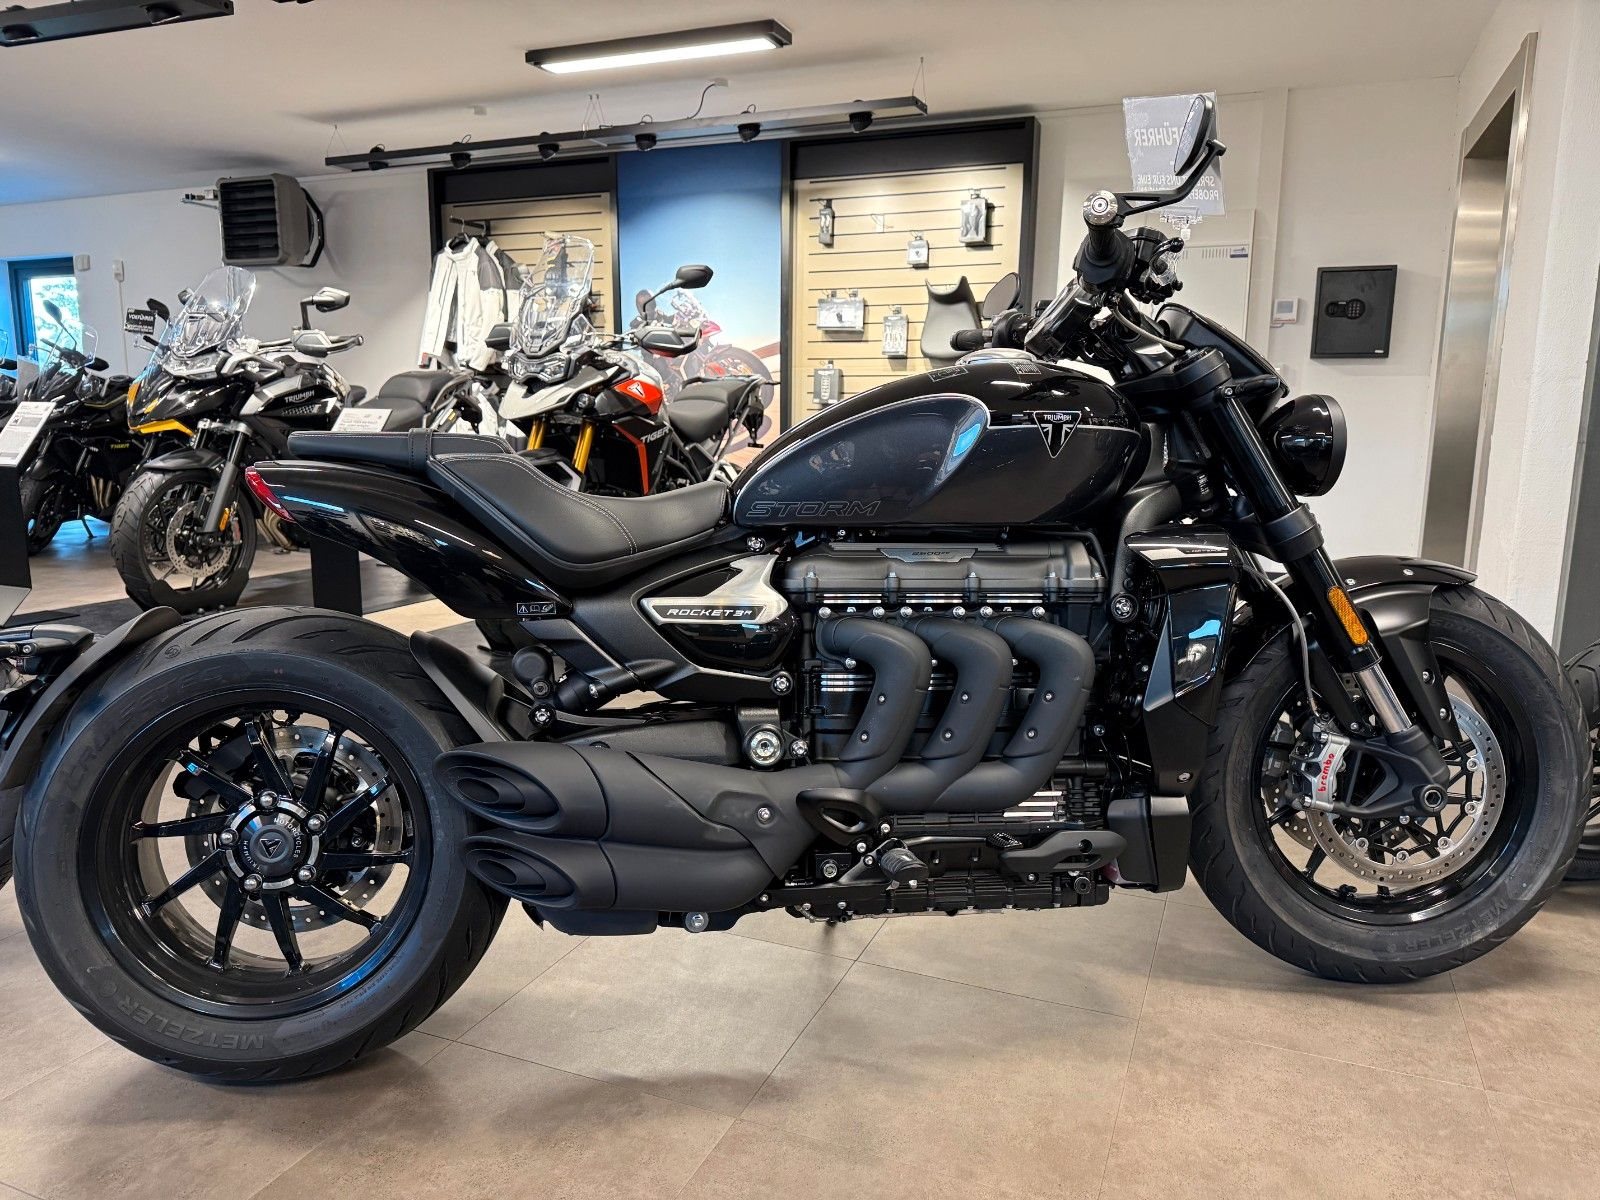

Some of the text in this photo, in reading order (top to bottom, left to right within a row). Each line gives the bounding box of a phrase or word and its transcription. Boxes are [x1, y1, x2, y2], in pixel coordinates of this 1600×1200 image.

[284, 390, 315, 403] TRIUMPH
[1043, 413, 1072, 422] TRIUMPH
[640, 426, 670, 443] TIGER
[746, 500, 881, 517] STORM
[1317, 753, 1335, 792] brembo
[274, 817, 302, 858] MOTORCYCLES
[243, 840, 261, 872] TRIUMPH
[117, 995, 264, 1050] METZELER
